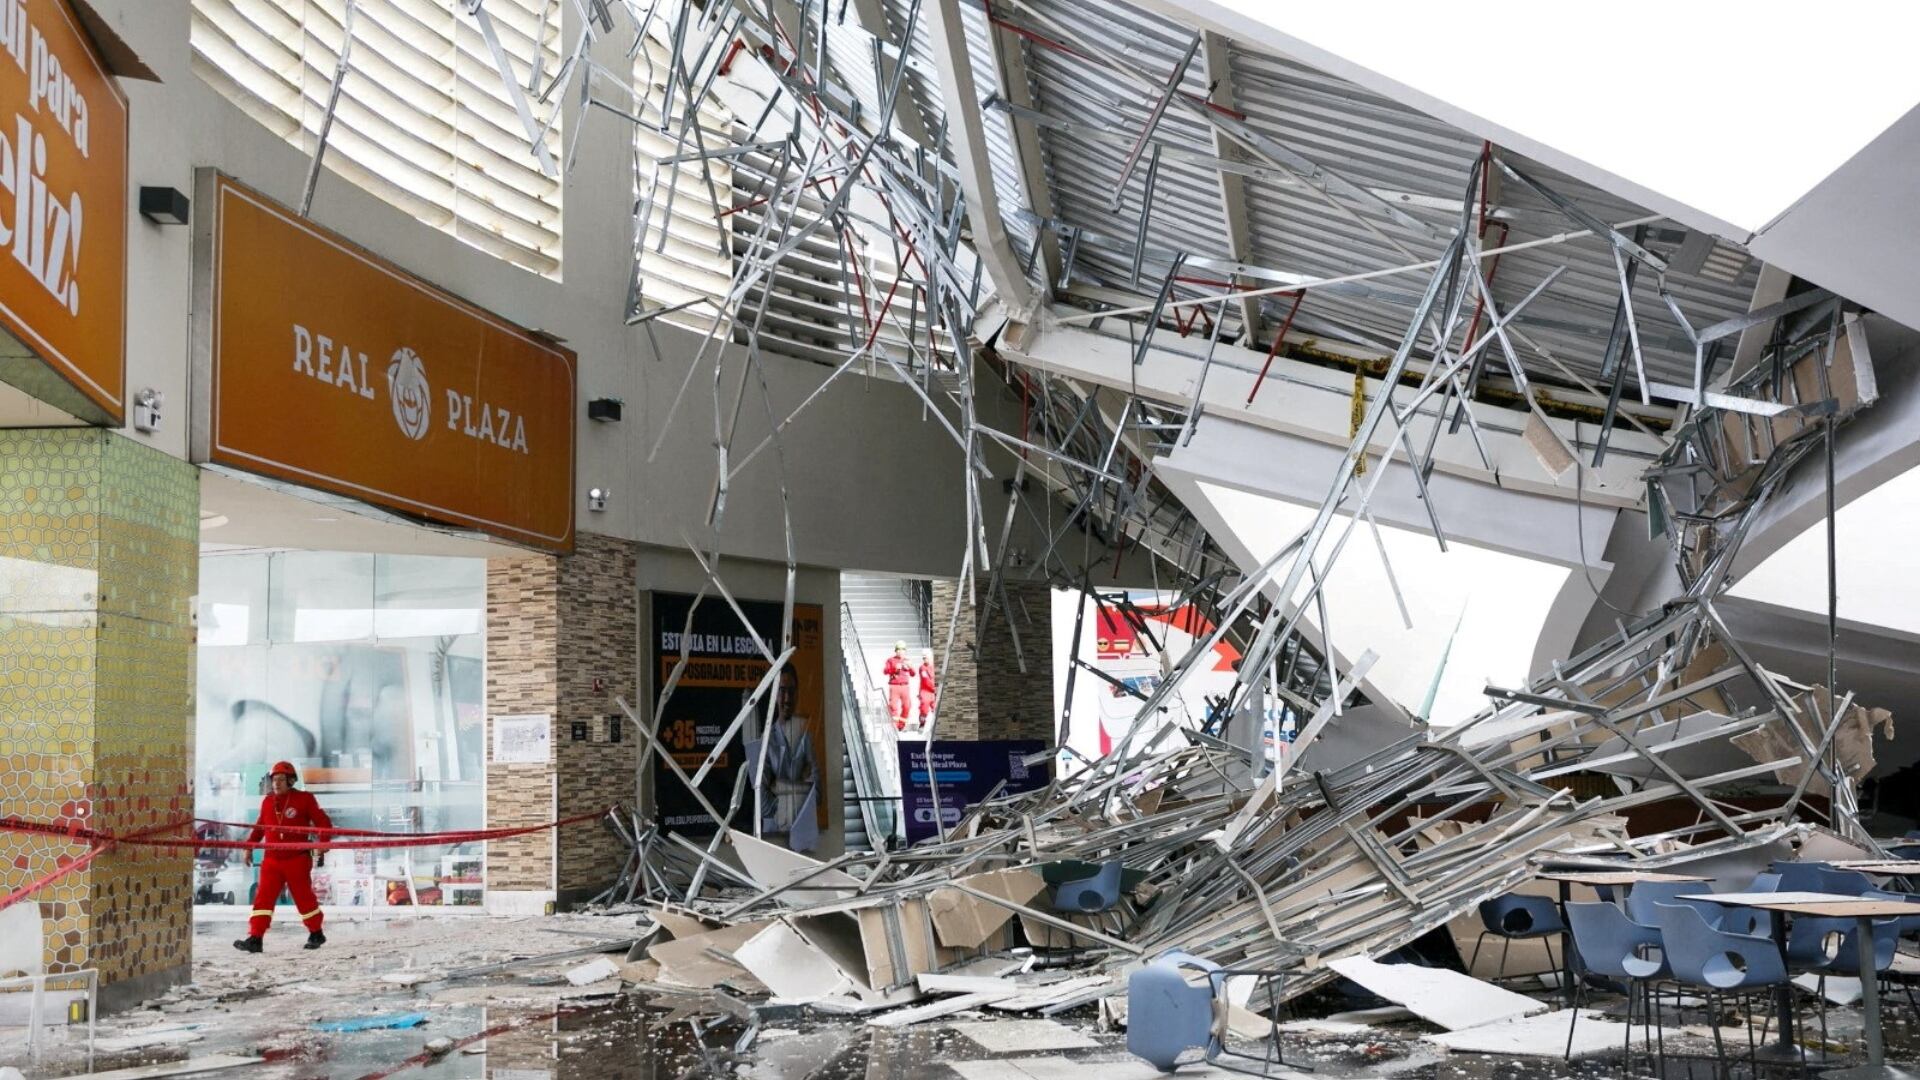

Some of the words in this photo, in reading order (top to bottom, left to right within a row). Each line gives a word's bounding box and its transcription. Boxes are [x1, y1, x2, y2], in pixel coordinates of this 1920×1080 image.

[29, 23, 90, 159] para
[293, 323, 375, 400] REAL
[446, 388, 529, 454] PLAZA
[661, 631, 704, 652] ESTDIA
[706, 634, 719, 653] EN
[720, 635, 733, 653] LA
[734, 664, 746, 682] DE
[663, 719, 696, 749] +35
